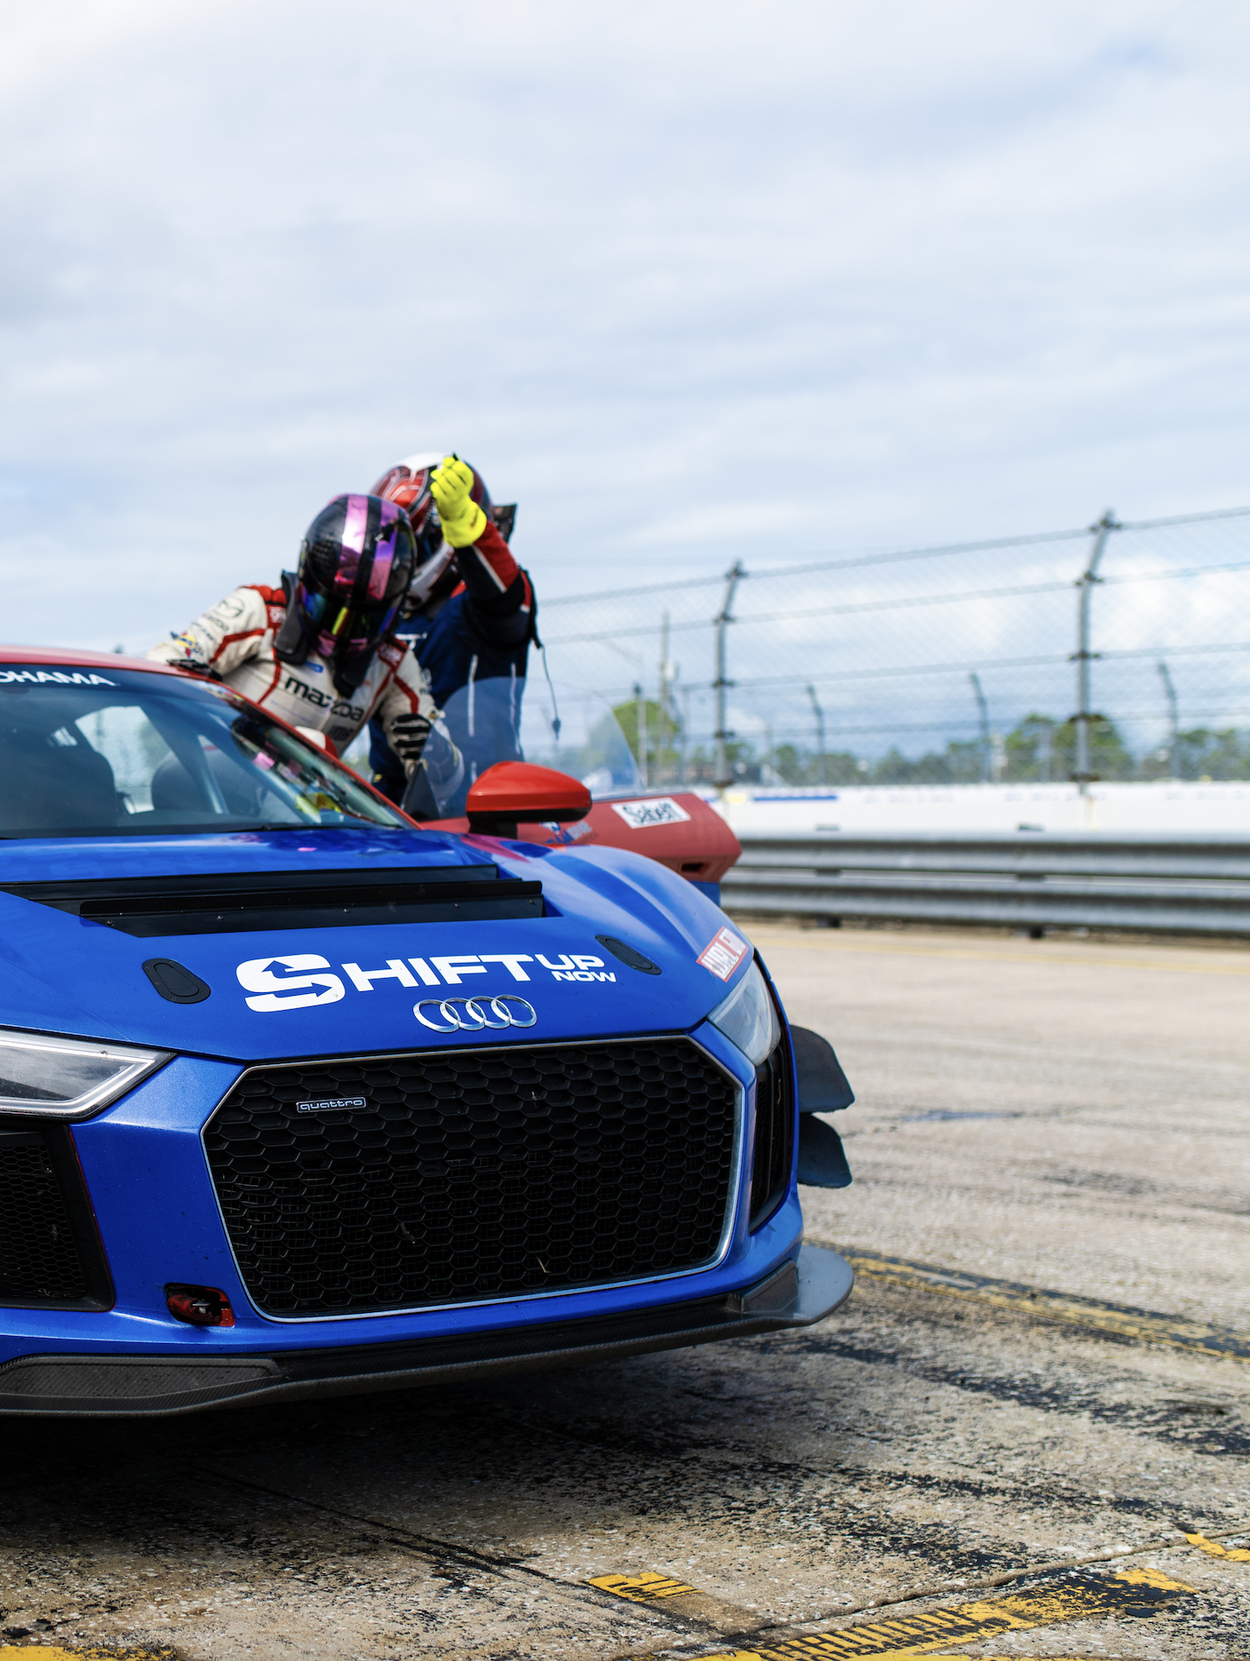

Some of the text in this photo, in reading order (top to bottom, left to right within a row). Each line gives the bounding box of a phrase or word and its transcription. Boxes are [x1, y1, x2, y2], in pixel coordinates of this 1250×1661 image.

[285, 676, 365, 722] mazda
[552, 970, 617, 983] NOW
[700, 941, 740, 980] WRL
[236, 953, 605, 1013] SHIFT UP
[299, 1099, 363, 1111] quattro
